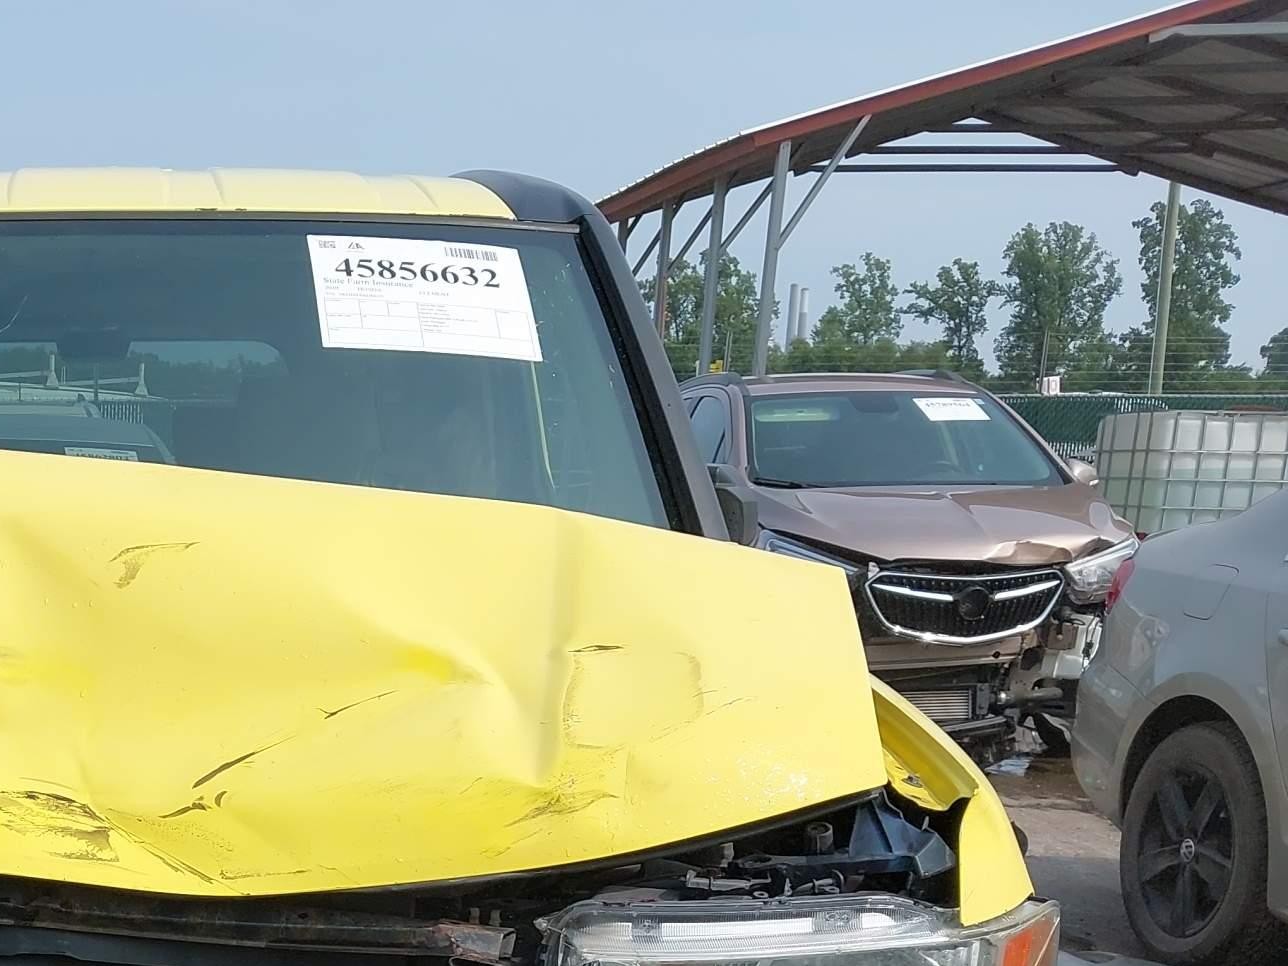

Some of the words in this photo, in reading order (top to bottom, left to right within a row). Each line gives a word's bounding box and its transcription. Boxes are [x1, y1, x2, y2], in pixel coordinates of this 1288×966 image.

[323, 277, 345, 285] State
[347, 278, 370, 286] Farm
[372, 279, 414, 288] Insurance
[335, 258, 500, 288] 45856632
